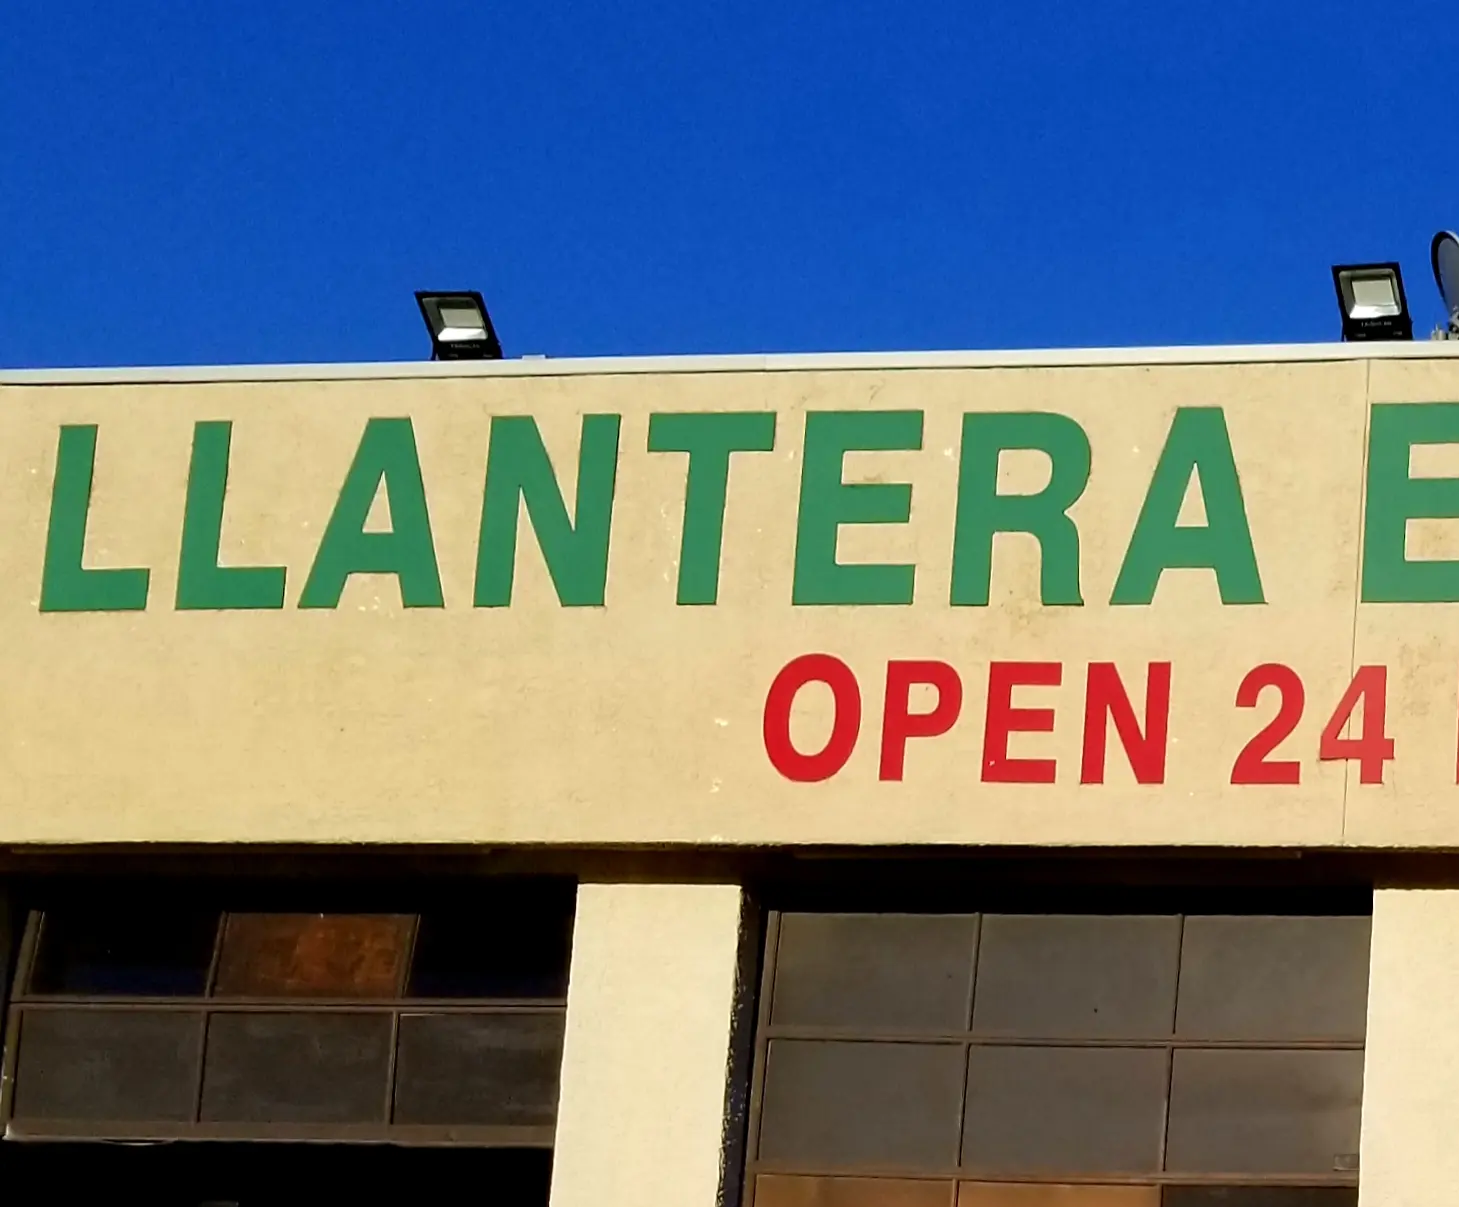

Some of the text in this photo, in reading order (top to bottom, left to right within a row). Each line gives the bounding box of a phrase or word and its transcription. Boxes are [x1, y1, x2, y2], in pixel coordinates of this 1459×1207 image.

[40, 405, 1266, 613] LLANTERA
[763, 653, 1172, 786] OPEN
[1230, 663, 1395, 786] 24
